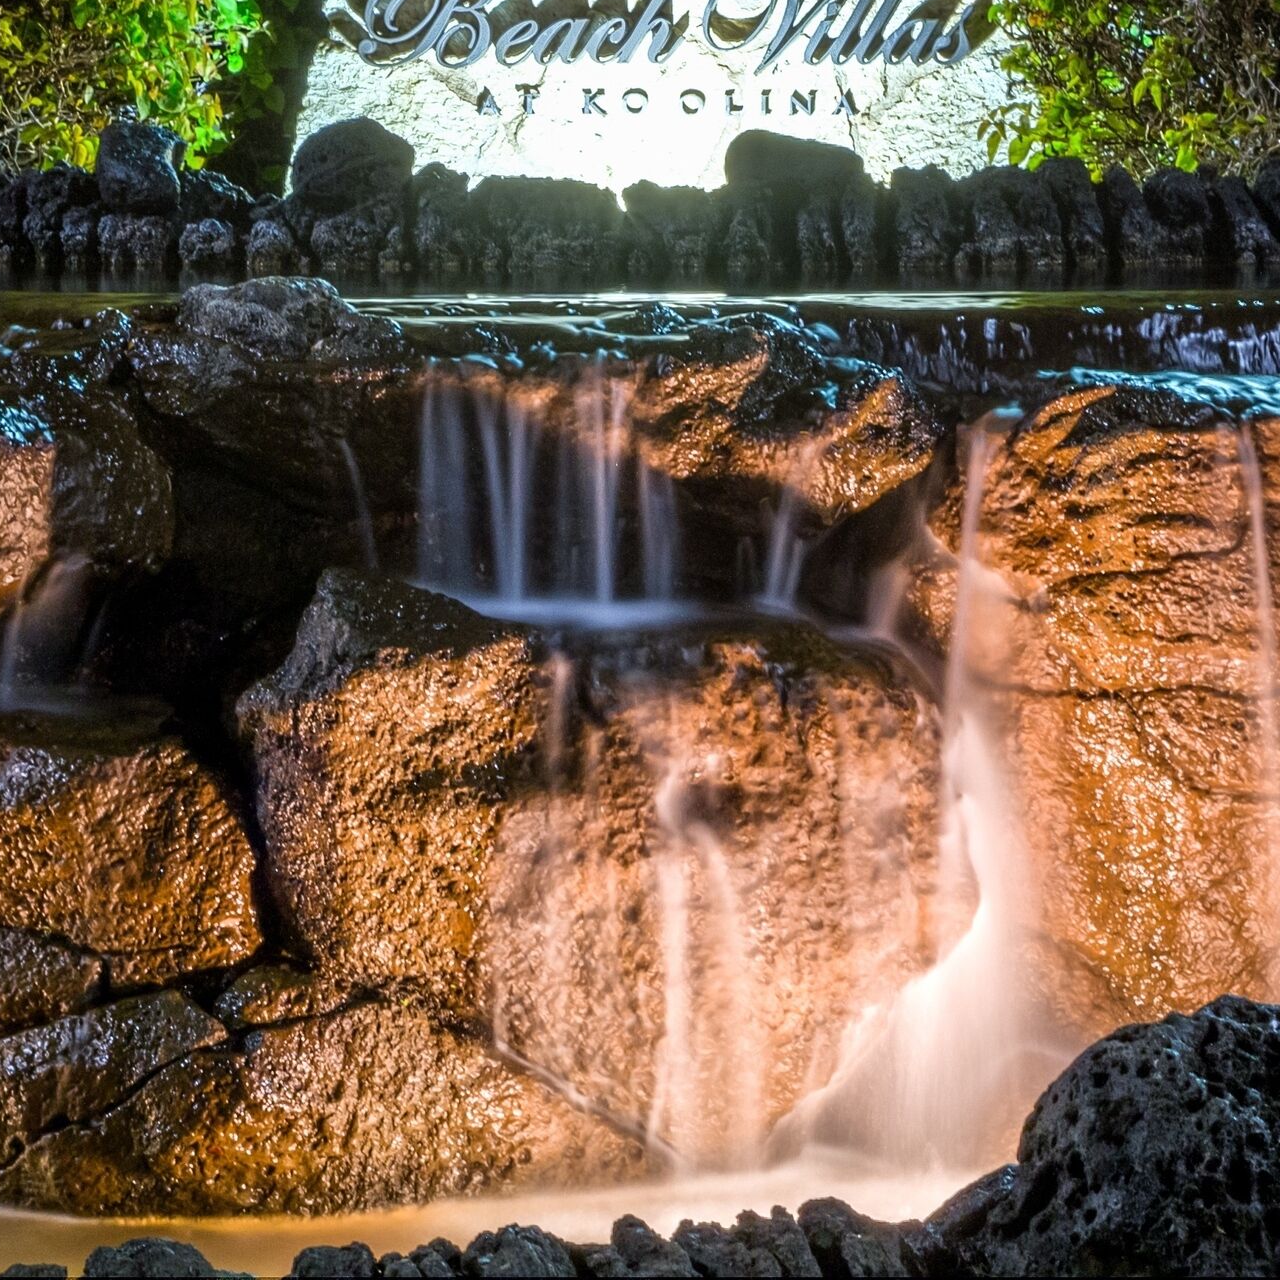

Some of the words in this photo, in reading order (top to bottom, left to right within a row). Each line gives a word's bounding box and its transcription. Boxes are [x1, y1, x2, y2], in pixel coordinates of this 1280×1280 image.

[478, 86, 540, 116] AT
[581, 88, 649, 116] KO
[679, 88, 861, 116] OLINA
